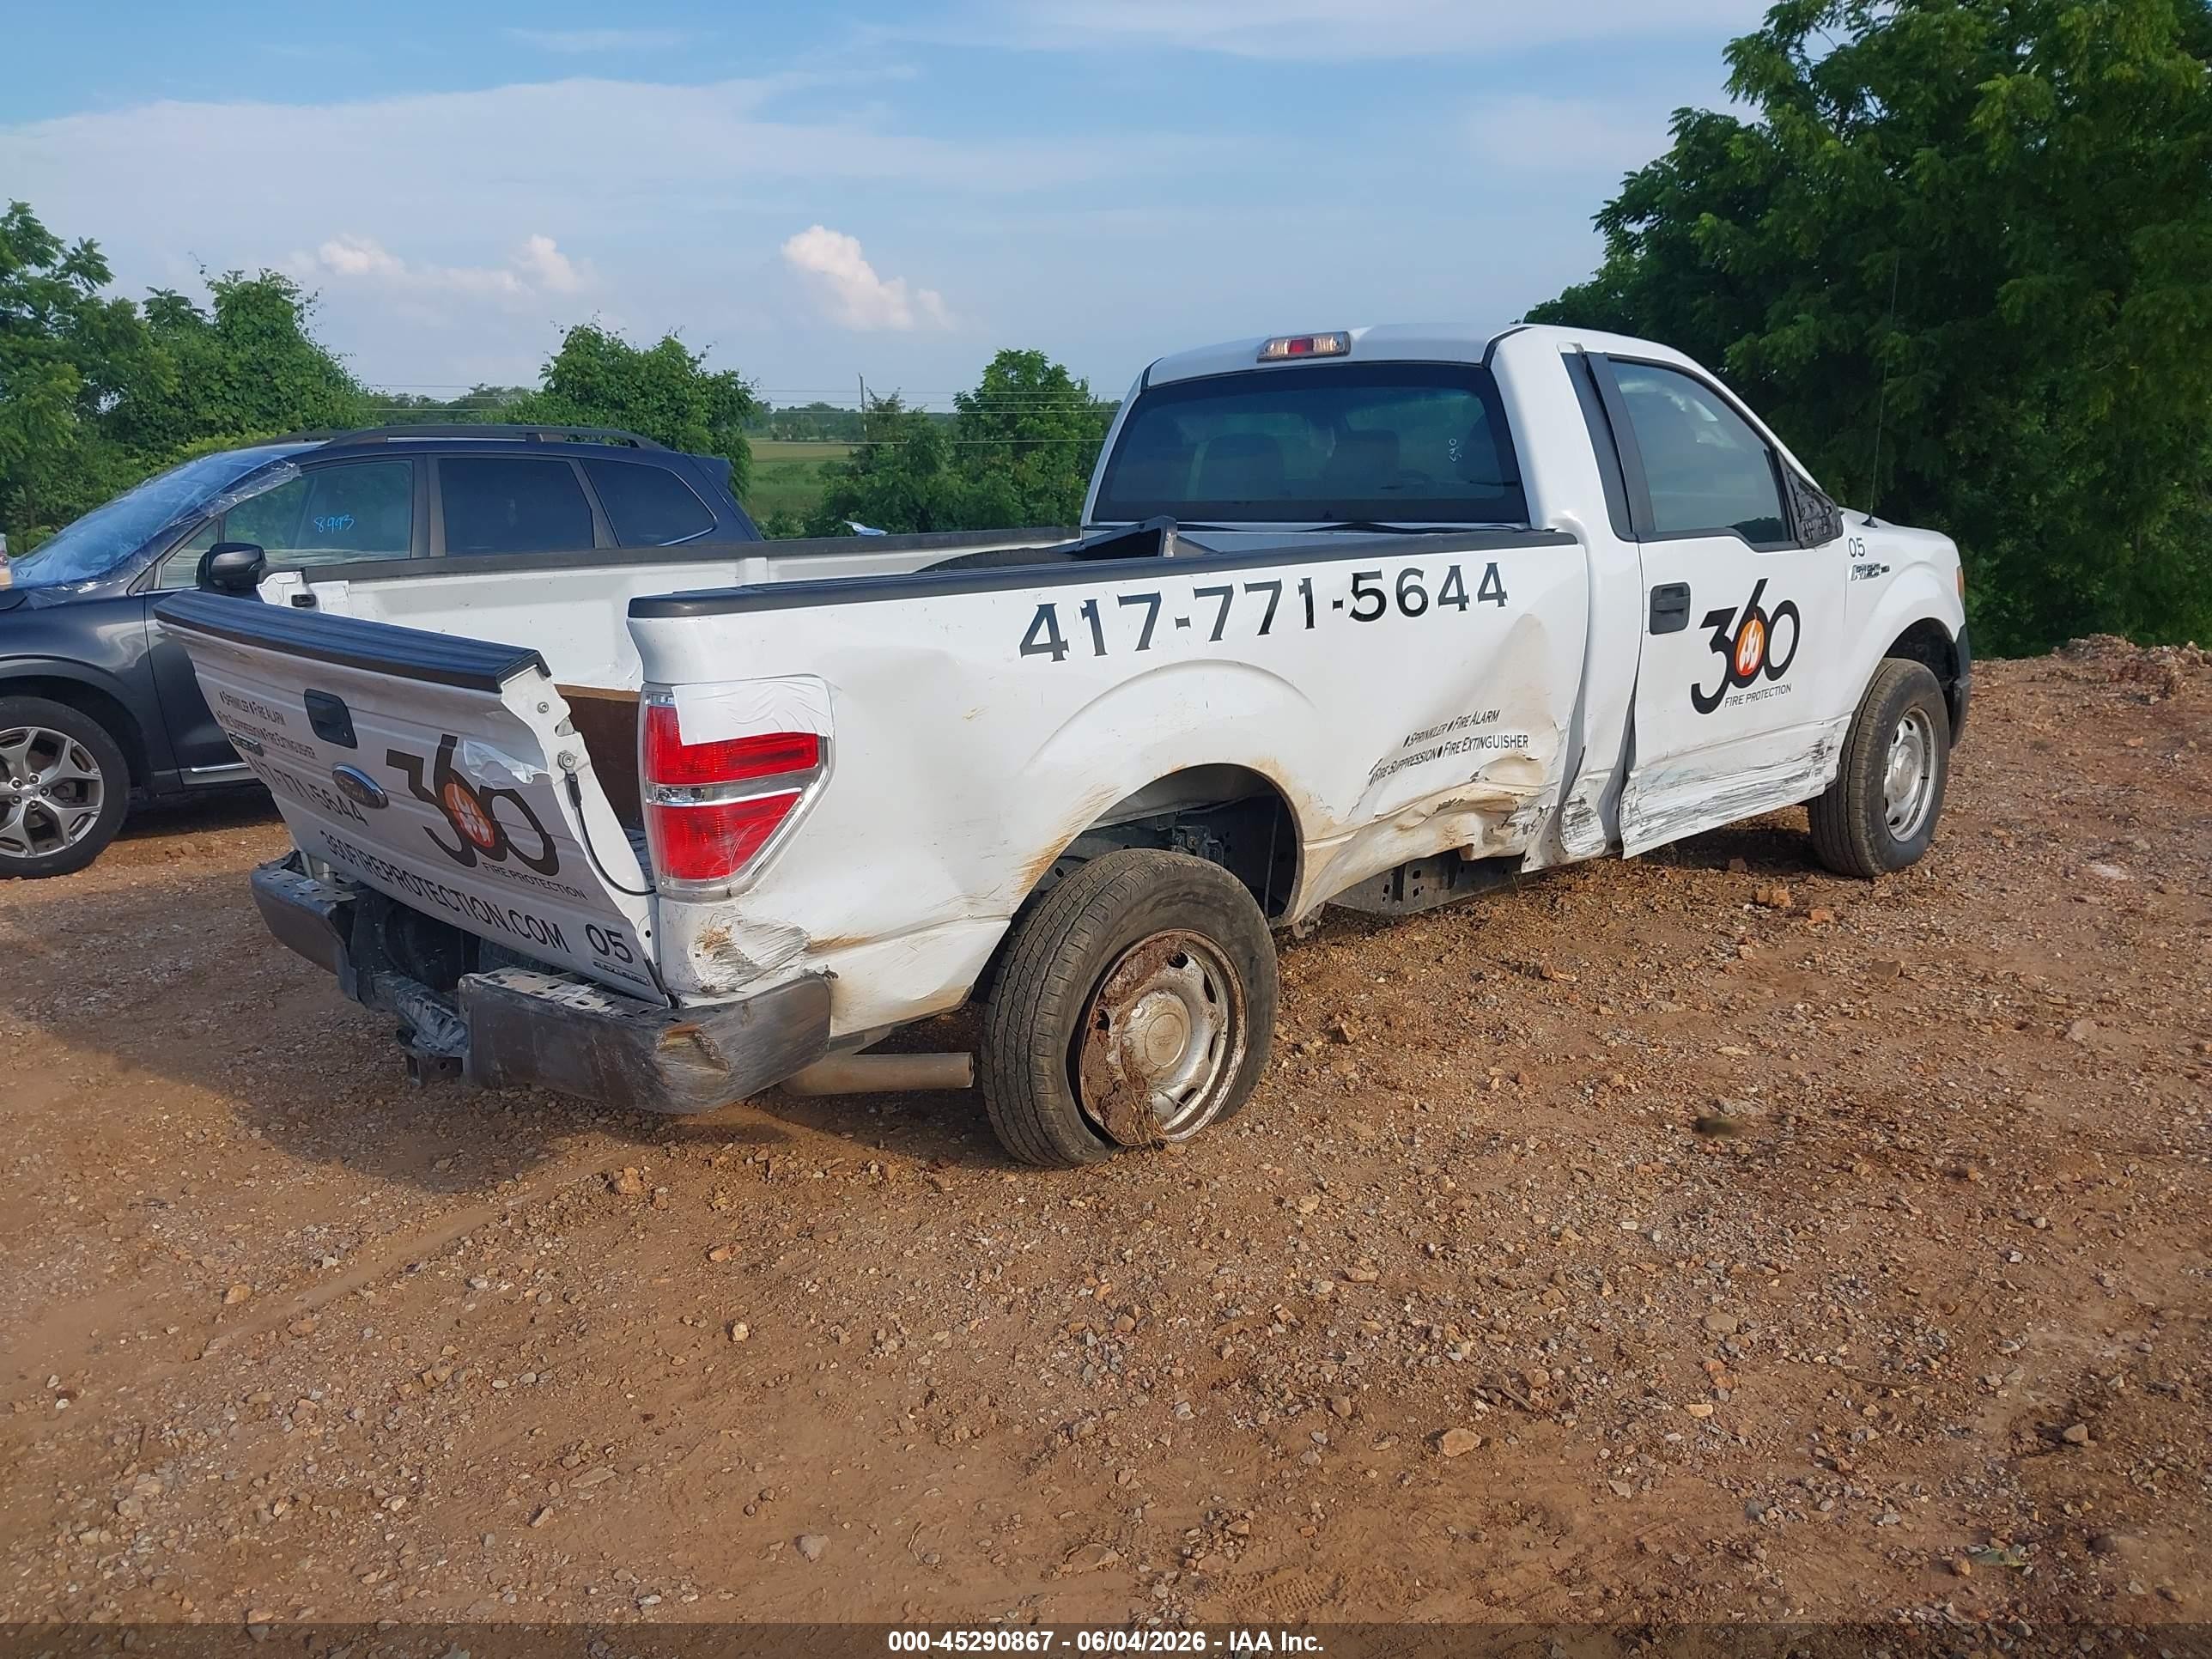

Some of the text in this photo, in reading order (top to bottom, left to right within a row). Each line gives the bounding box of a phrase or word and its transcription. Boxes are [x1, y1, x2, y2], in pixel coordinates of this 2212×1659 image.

[1848, 537, 1866, 558] 05
[1018, 562, 1509, 663] 417-771-5644
[1691, 577, 1801, 715] 360
[1724, 682, 1792, 708] FIRE PROTECTION
[1452, 715, 1470, 731] FIRE
[1470, 708, 1501, 726] ALARM
[1442, 740, 1462, 758] FIRE
[1462, 734, 1528, 752] EXTINGUISHER
[386, 733, 560, 877] 360
[319, 830, 572, 954] 360FIREPROTECTION.COM
[482, 861, 589, 901] FIRE PROTECTION
[585, 923, 634, 963] 05
